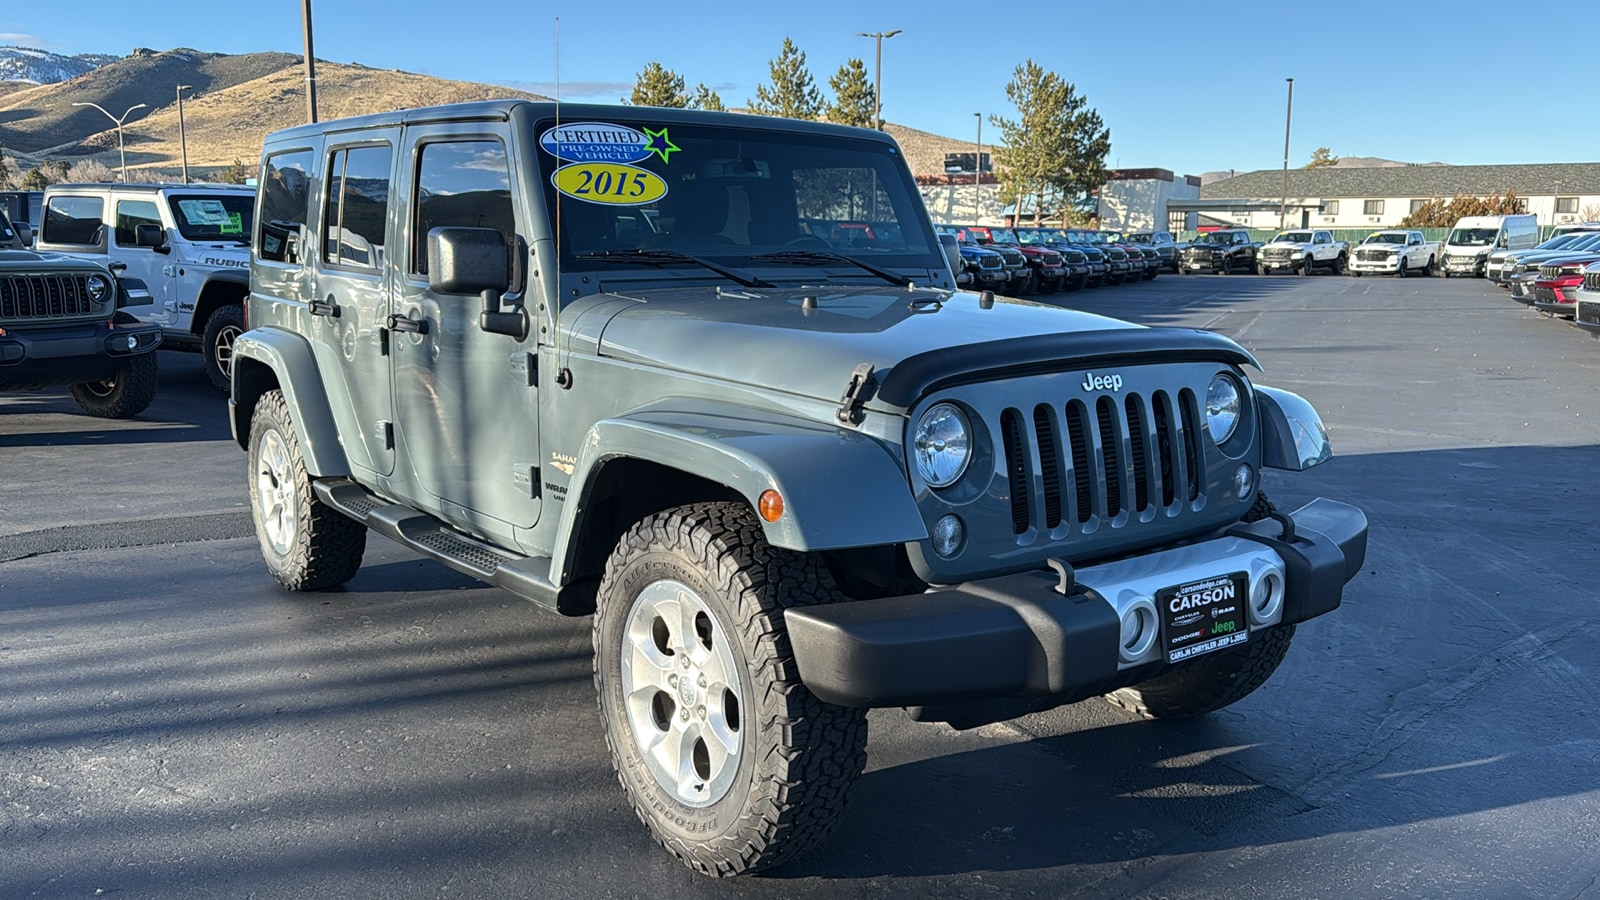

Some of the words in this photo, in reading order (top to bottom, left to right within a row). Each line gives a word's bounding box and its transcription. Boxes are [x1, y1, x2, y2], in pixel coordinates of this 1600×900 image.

[551, 130, 640, 144] CERTIFIED
[560, 144, 640, 153] PRE-OWNED
[575, 152, 632, 160] VEHICLE
[574, 170, 648, 197] 2015
[179, 301, 195, 311] Jeep
[1081, 372, 1123, 392] Jeep
[1181, 579, 1228, 594] carsondodge.com
[1169, 585, 1235, 613] CARSON
[1174, 611, 1200, 621] CHRYSLER
[1218, 606, 1235, 614] RAM
[1211, 620, 1235, 634] Jeep
[1172, 631, 1201, 644] DODGE
[1191, 641, 1217, 655] CHRYSLER
[1217, 637, 1230, 647] JEEP
